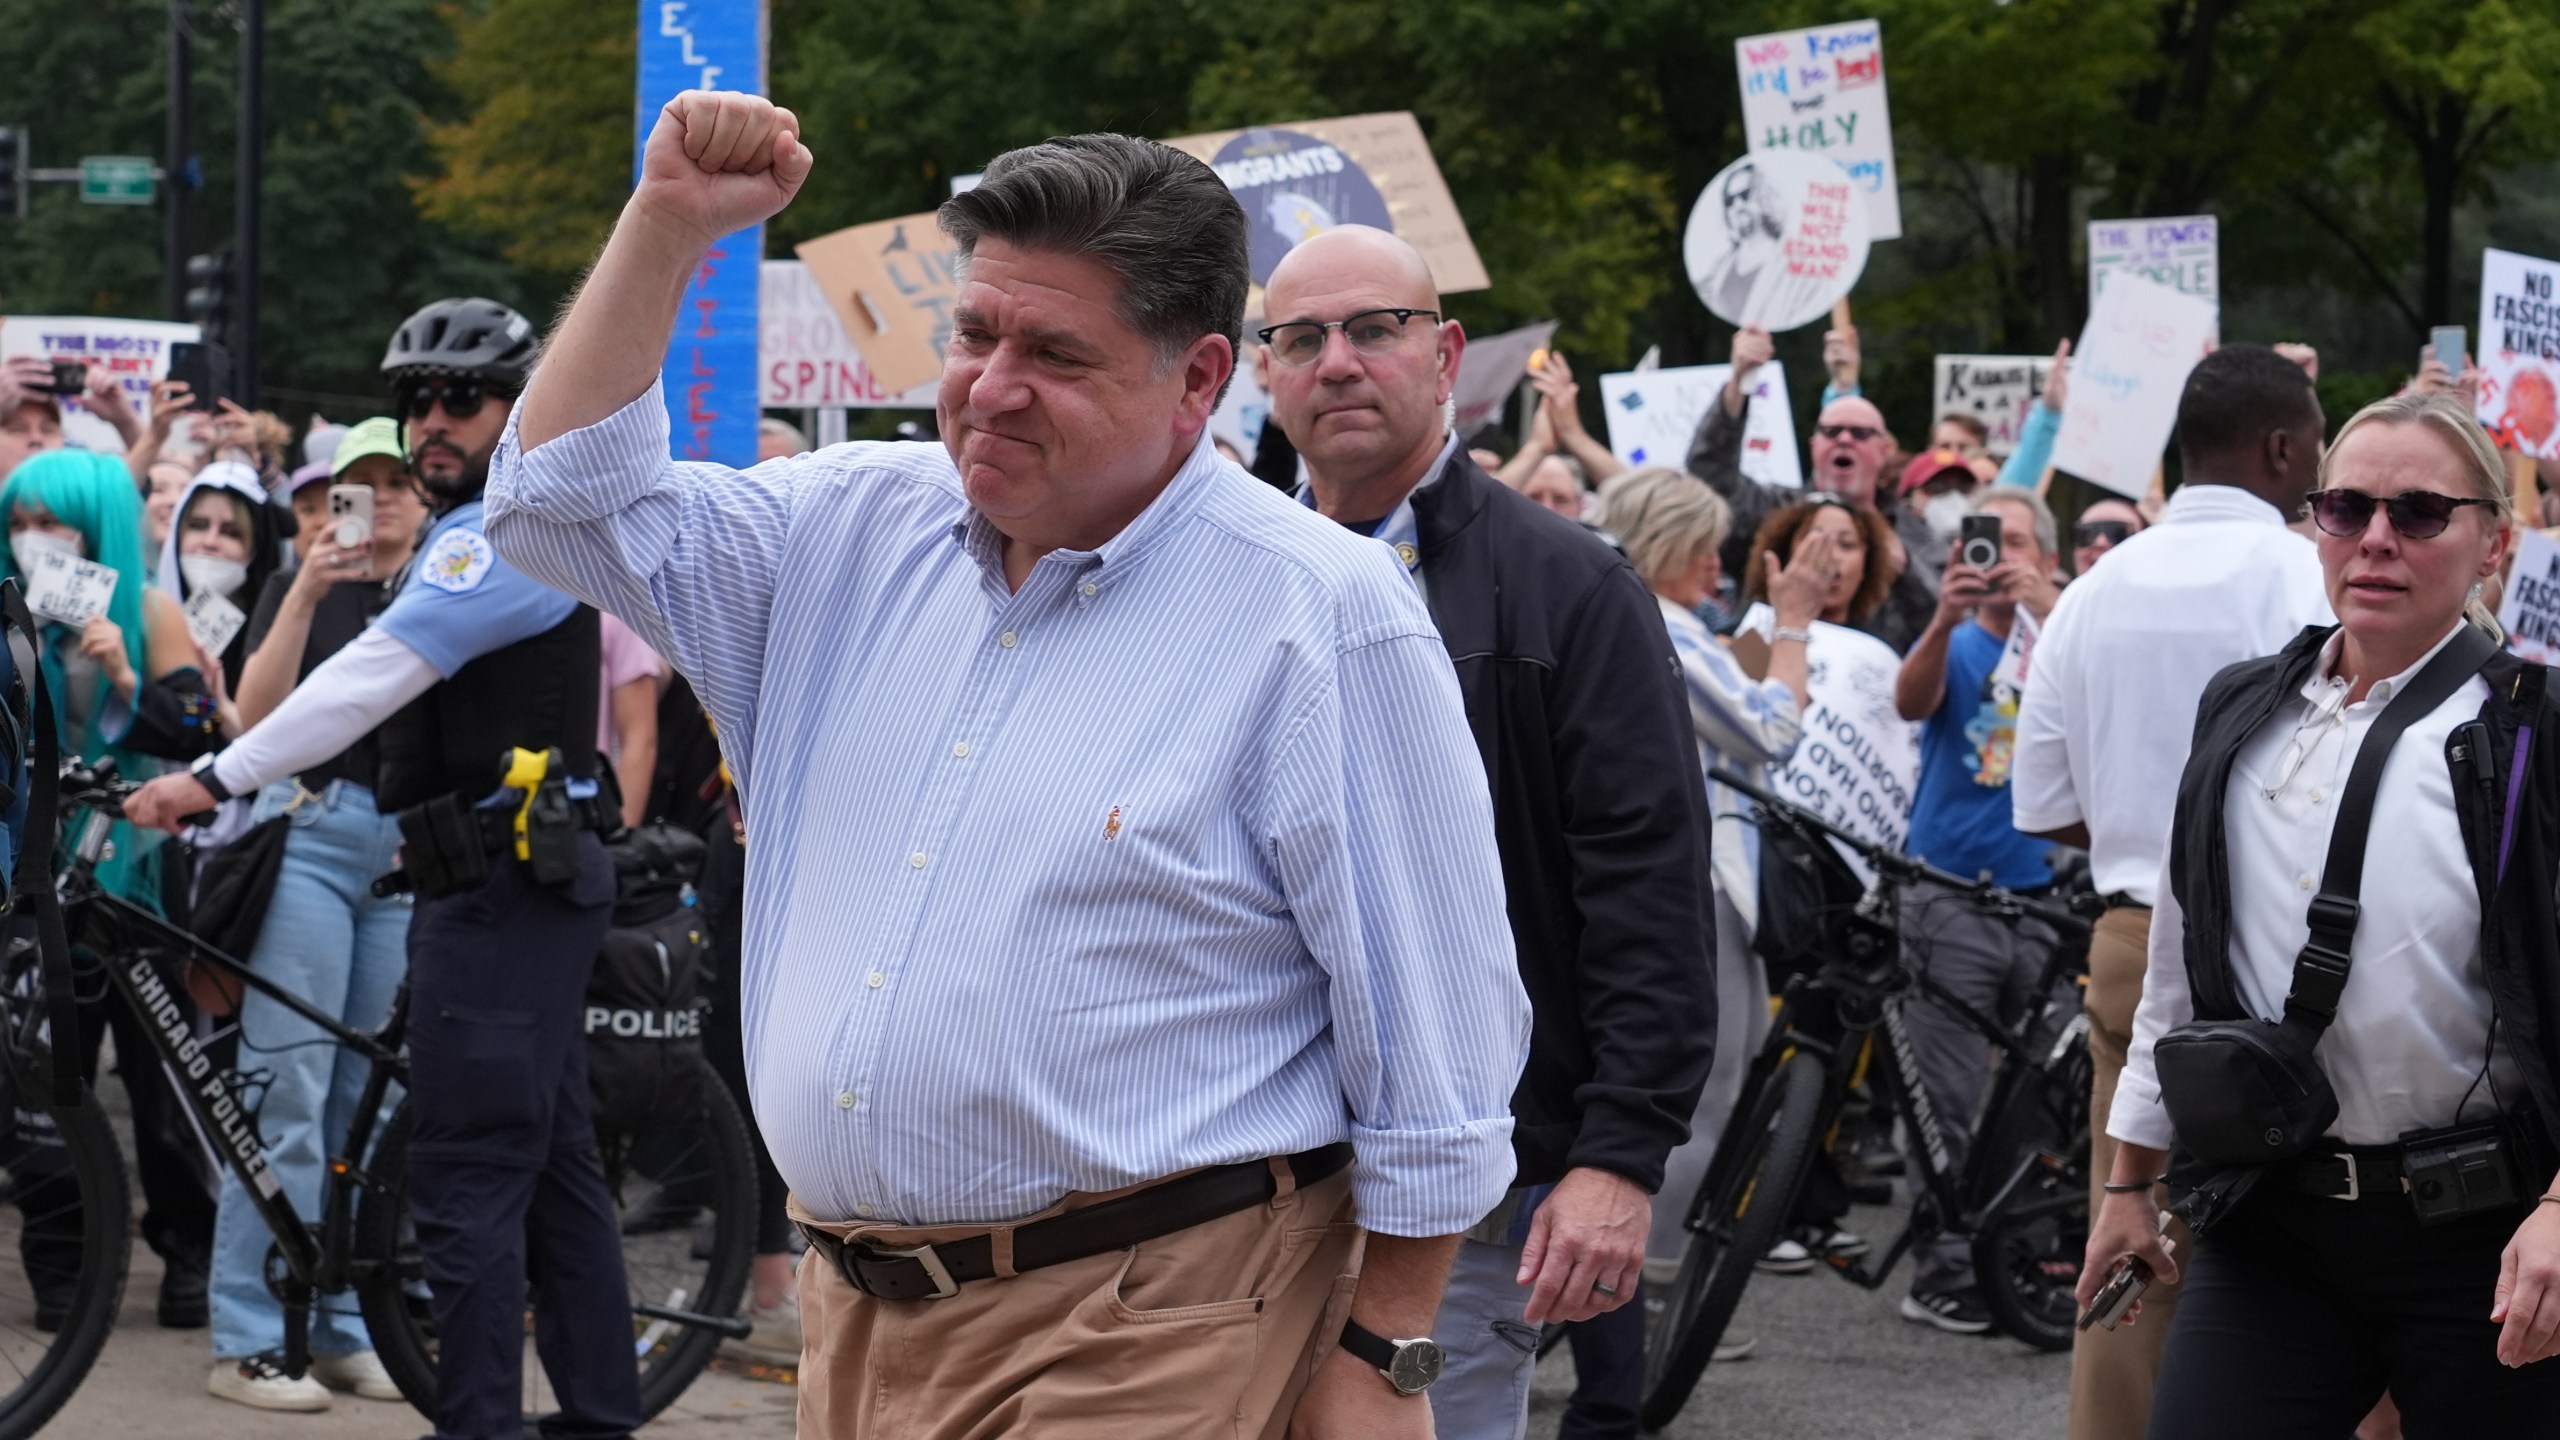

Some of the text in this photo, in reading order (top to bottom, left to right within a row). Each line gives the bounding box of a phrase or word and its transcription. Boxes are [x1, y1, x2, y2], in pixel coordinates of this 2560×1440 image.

[1762, 112, 1858, 149] HOLY
[2524, 270, 2554, 300] NO
[1809, 743, 1859, 794] HAD
[585, 1006, 701, 1038] POLICE
[129, 957, 267, 1177] CHICAGO POLICE
